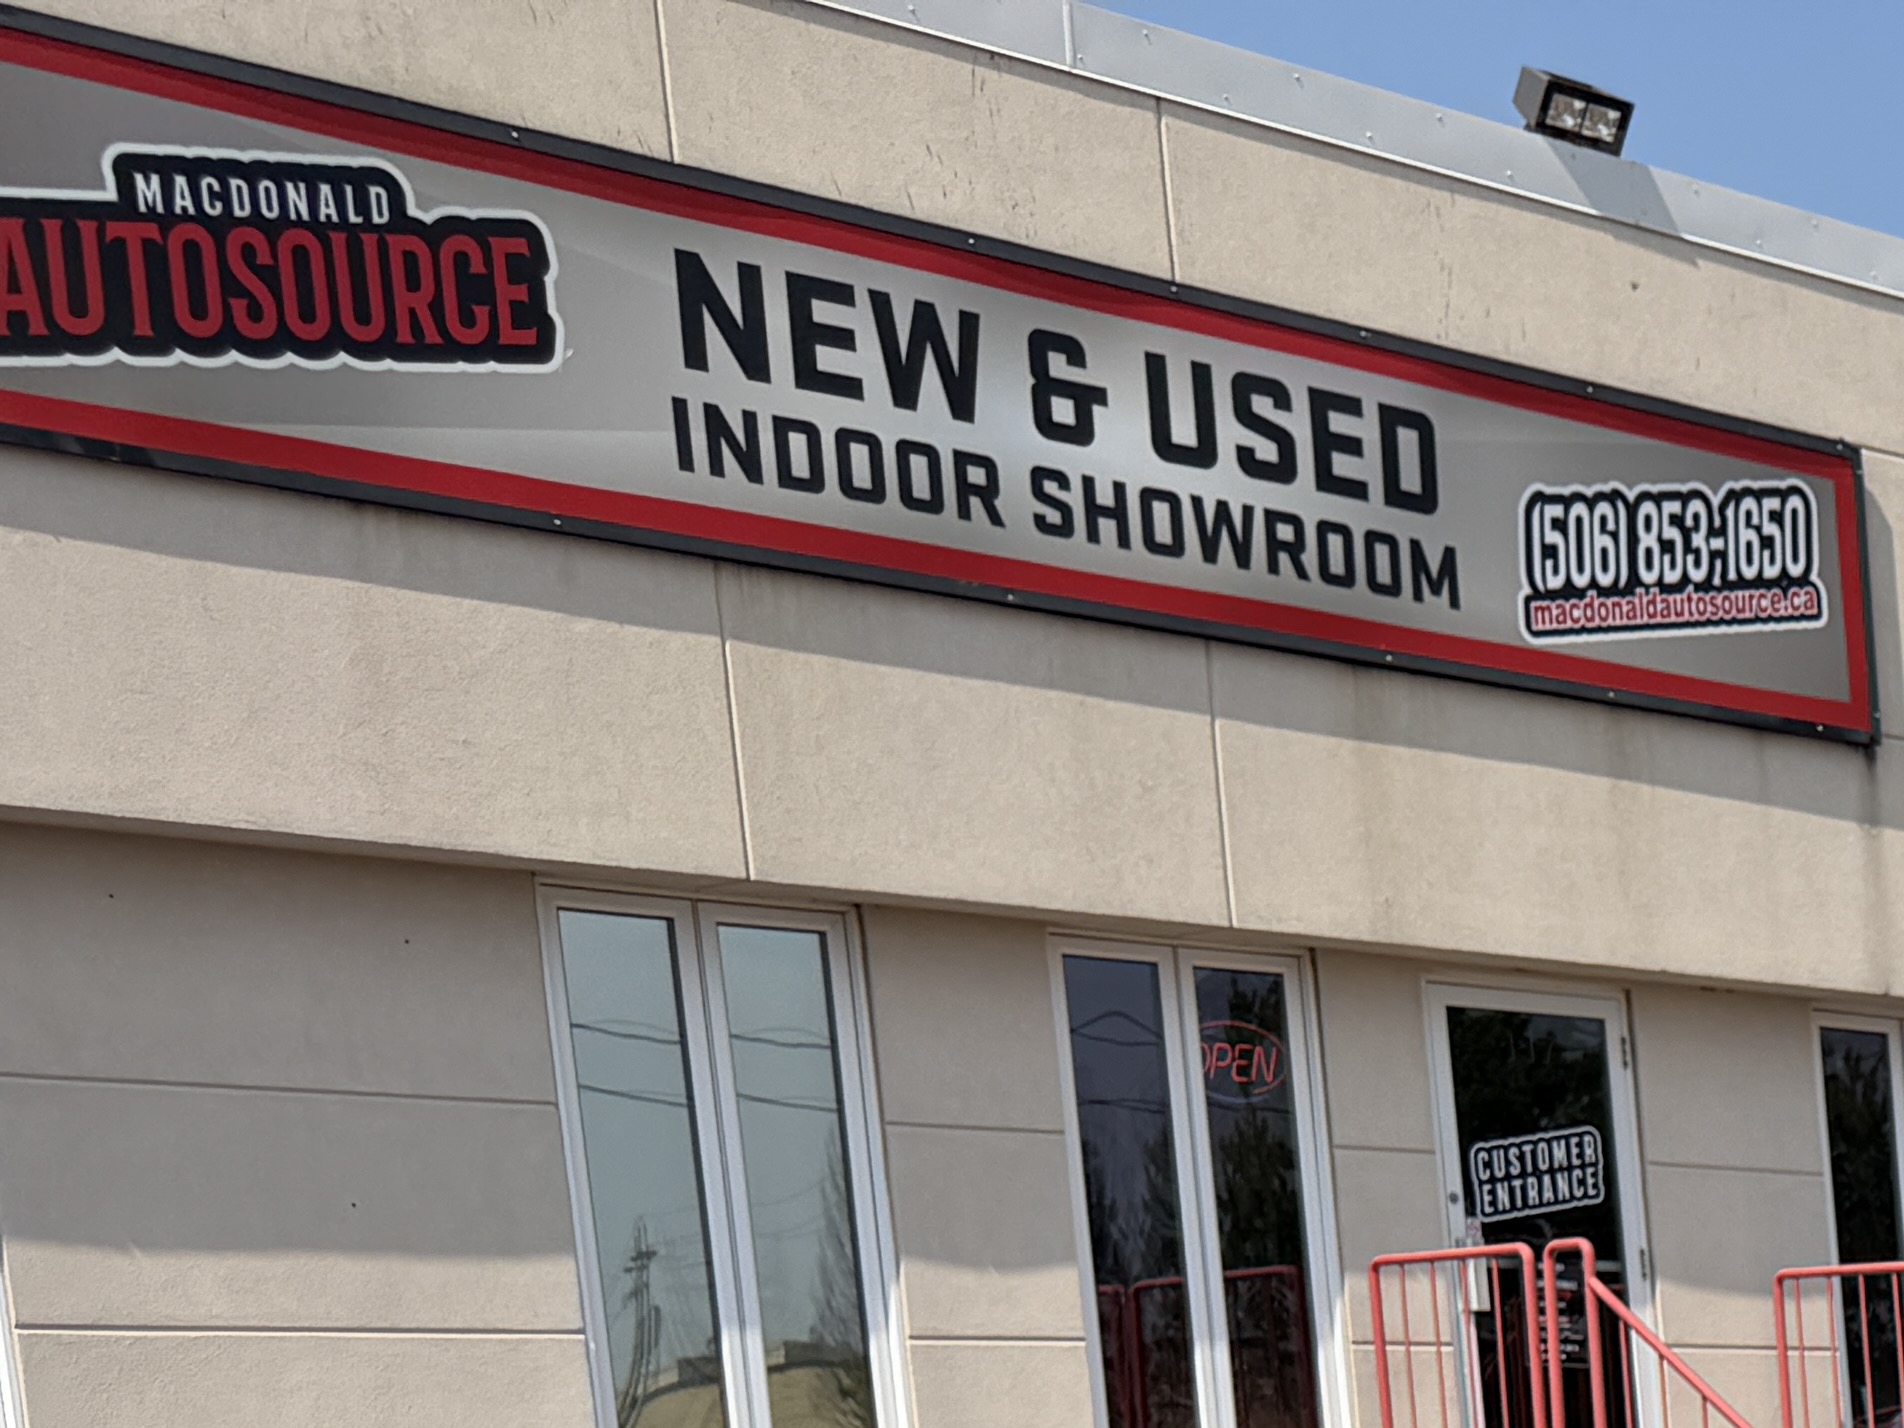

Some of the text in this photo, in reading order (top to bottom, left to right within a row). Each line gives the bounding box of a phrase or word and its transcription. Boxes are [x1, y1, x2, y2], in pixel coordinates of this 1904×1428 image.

[133, 172, 391, 226] MACDONALD
[0, 216, 539, 346] AUTOSOURCE
[673, 247, 1441, 516] NEW & USED
[670, 395, 1462, 610] INDOOR SHOWROOM
[1531, 493, 1808, 594] (506) 853-1650
[1531, 586, 1819, 632] macdonaldautosource.ca
[1476, 1134, 1597, 1181] CUSTOMER
[1482, 1166, 1598, 1215] ENTRANCE
